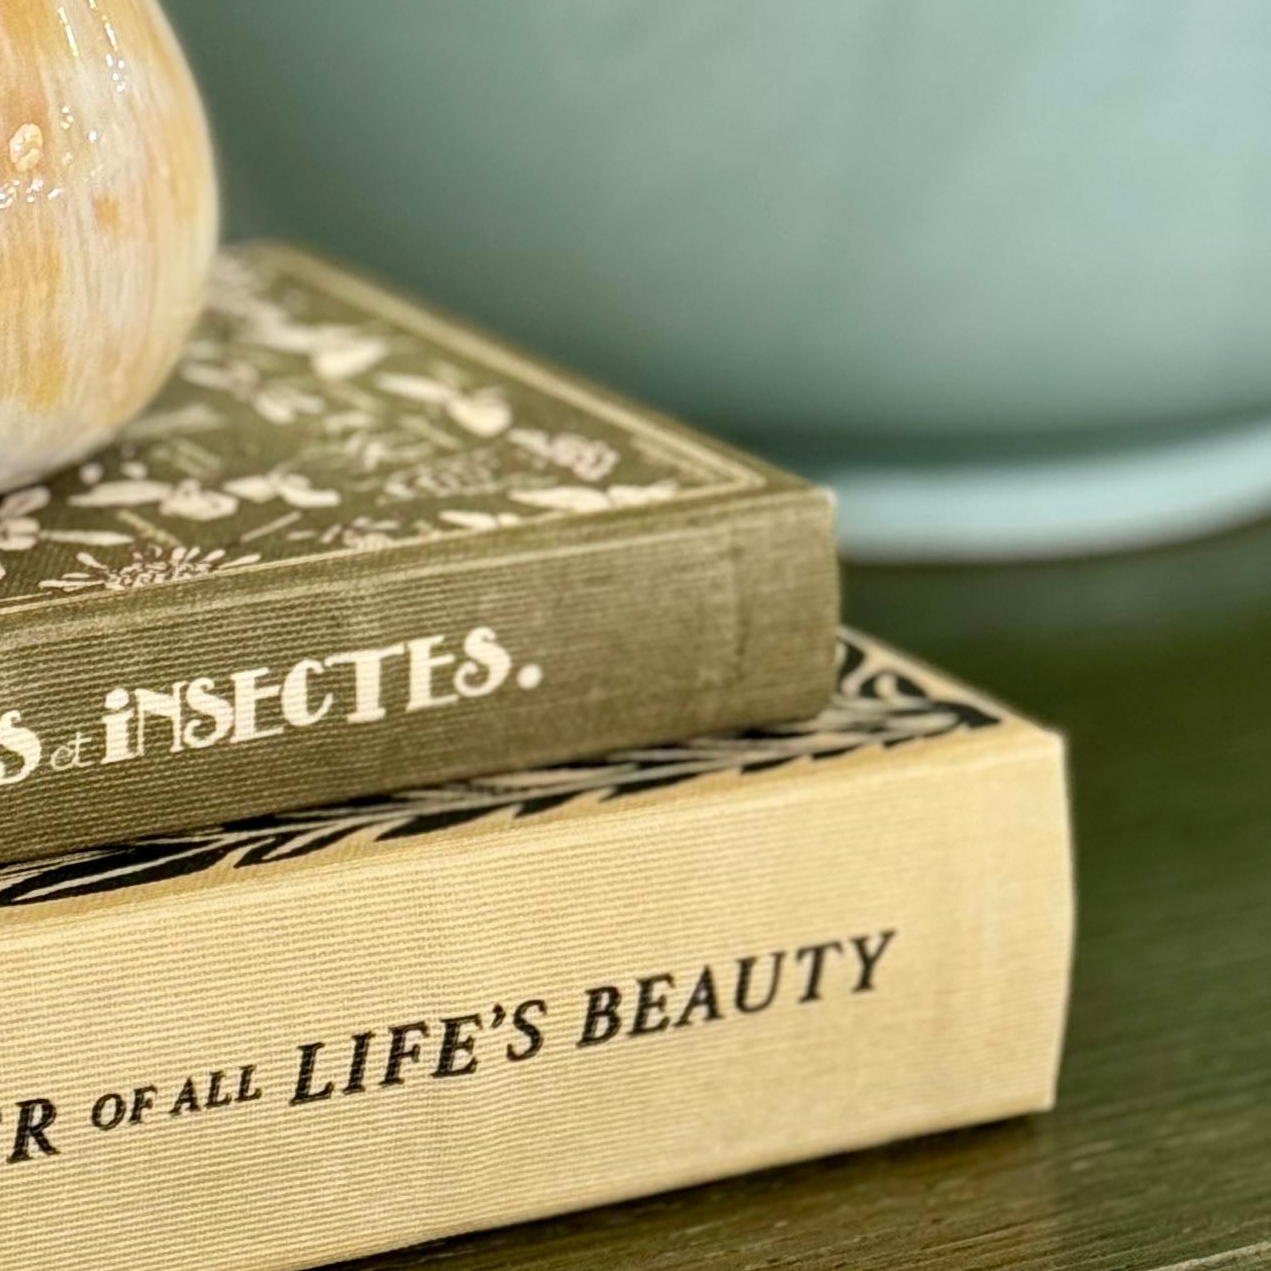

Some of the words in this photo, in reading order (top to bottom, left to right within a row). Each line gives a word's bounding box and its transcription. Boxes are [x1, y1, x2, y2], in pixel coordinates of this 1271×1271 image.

[50, 731, 95, 771] et
[91, 1085, 158, 1131] OF
[169, 1064, 262, 1116] ALL
[288, 999, 548, 1107] LIFE'S
[575, 930, 895, 1048] BEAUTY
